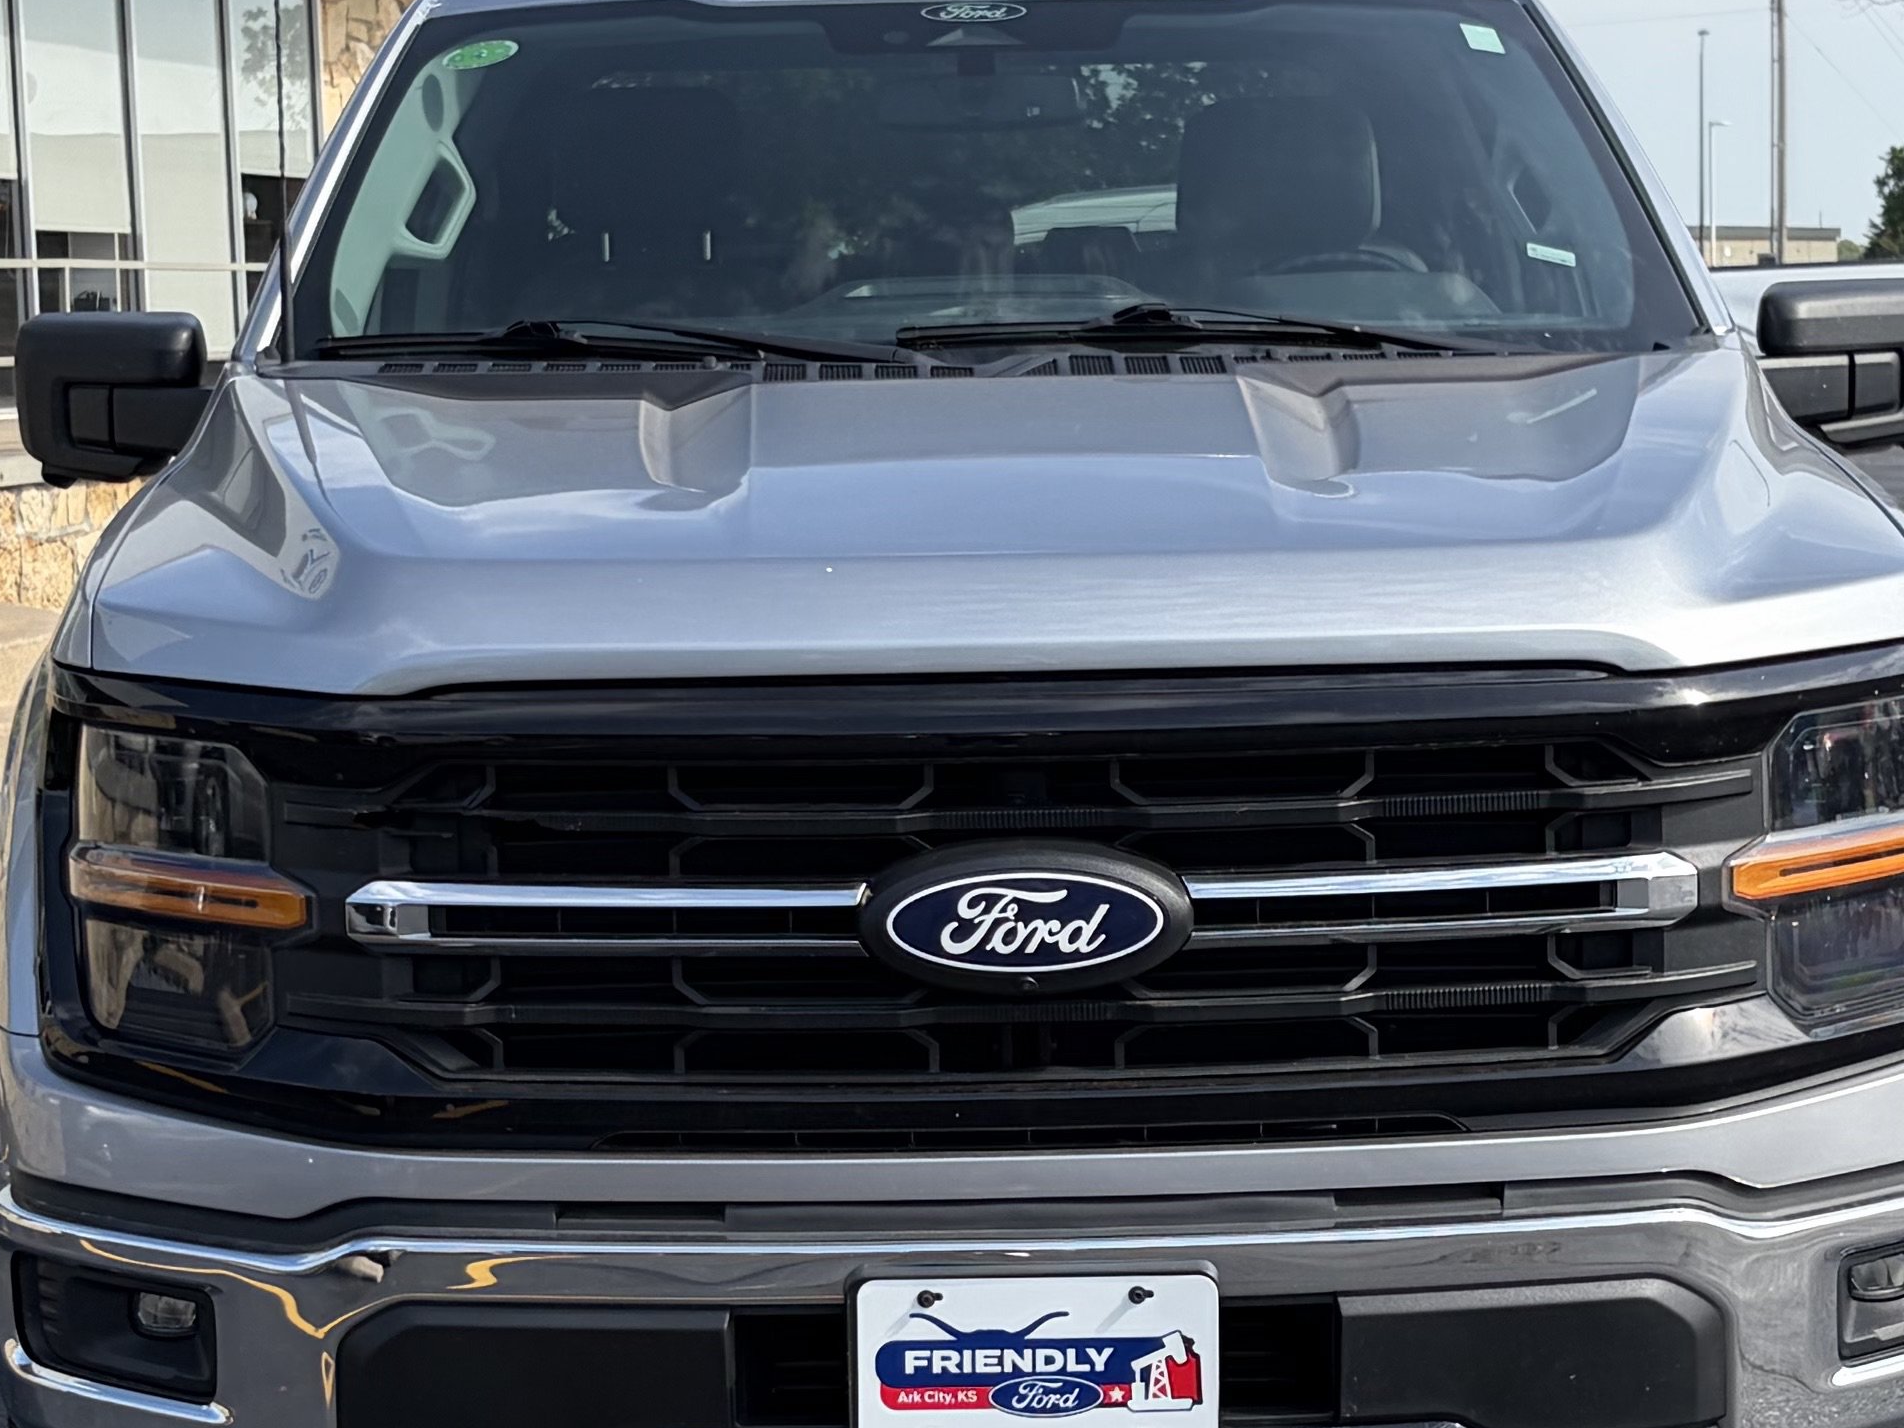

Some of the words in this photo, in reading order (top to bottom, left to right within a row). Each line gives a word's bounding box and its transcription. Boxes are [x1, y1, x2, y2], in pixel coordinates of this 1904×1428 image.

[939, 4, 1008, 19] Ford
[940, 887, 1110, 955] Ford
[905, 1348, 1114, 1375] FRIENDLY
[897, 1391, 922, 1404] Ark
[923, 1390, 956, 1405] City,
[957, 1390, 978, 1403] KS
[1012, 1380, 1080, 1409] Ford
